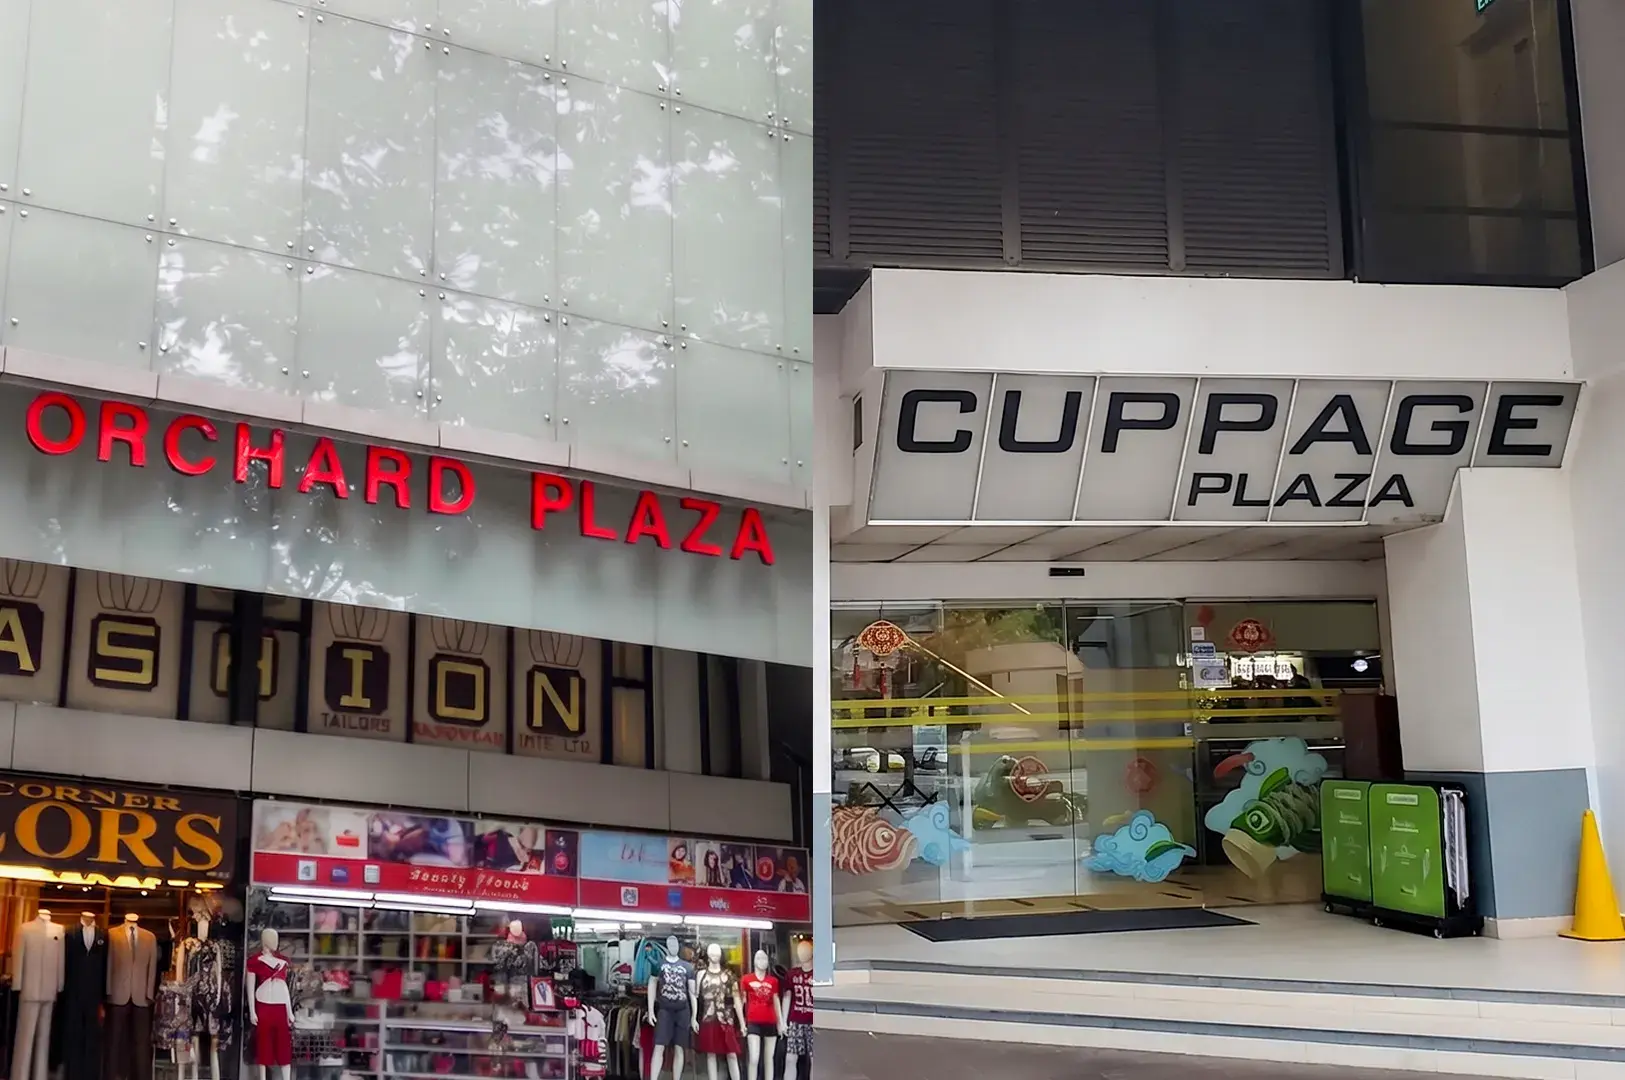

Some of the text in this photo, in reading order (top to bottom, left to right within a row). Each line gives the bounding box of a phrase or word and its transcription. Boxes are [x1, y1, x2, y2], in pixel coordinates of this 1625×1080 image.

[896, 388, 1565, 456] CUPPAGE
[26, 391, 776, 565] ORCHARD PLAZA
[1187, 472, 1414, 508] PLAZA
[320, 712, 391, 733] TAILORS
[0, 800, 224, 871] ORS
